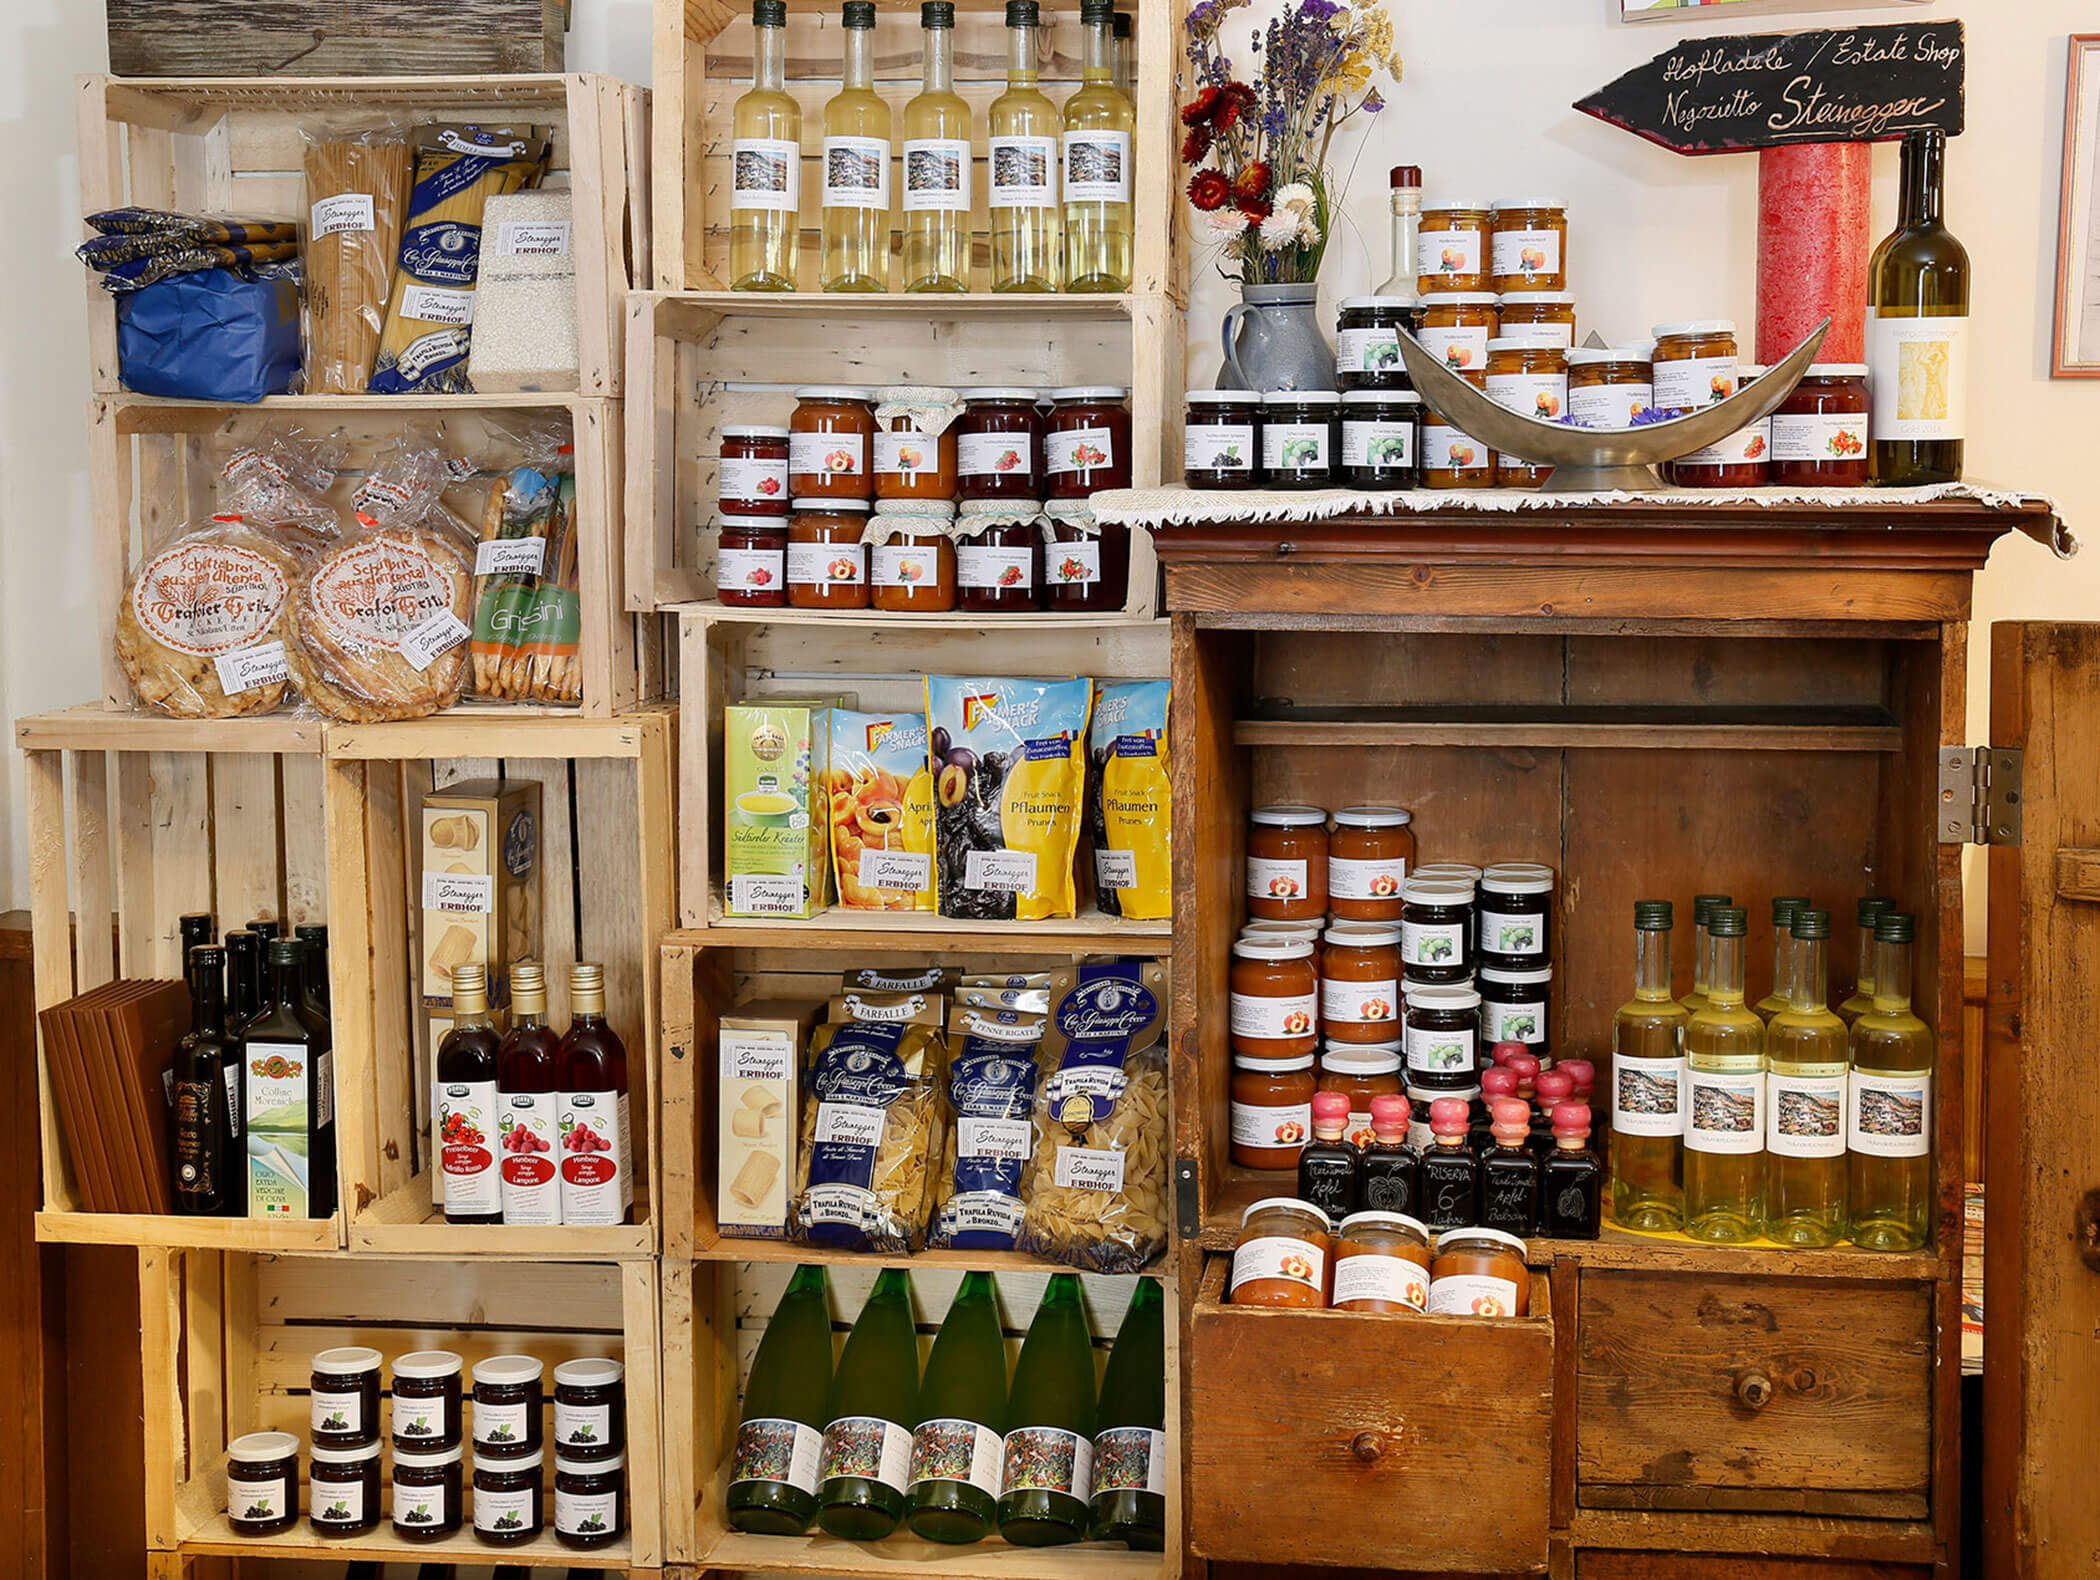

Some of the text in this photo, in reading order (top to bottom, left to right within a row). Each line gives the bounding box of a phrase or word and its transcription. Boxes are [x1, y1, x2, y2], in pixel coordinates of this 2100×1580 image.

[1831, 34, 1908, 66] Estate
[1913, 33, 1961, 71] Shop
[1662, 75, 1946, 136] Negozietto Steinegger
[323, 221, 366, 233] ERBHOF
[515, 246, 560, 255] ERBHOF
[420, 312, 465, 324] ERBHOF
[494, 563, 537, 573] ERBHOF
[971, 698, 1040, 724] FARMER'S
[994, 711, 1038, 735] SNACK
[872, 725, 926, 745] FARMER'S
[889, 735, 926, 752] SNACK
[1011, 801, 1070, 815] Pflaumen
[1107, 799, 1158, 812] Pflaumen
[1026, 818, 1057, 827] Prunes
[1118, 816, 1142, 825] Prunes
[732, 826, 805, 846] Südtiroler Kräuter
[878, 879, 921, 890] ERBHOF
[984, 880, 1028, 891] ERBHOF
[440, 902, 483, 912] ERBHOF
[751, 903, 795, 912] ERBHOF
[875, 979, 927, 990] FARFALLE
[860, 1007, 909, 1019] FARFALLE
[977, 1023, 1034, 1037] PENNE RIGATE
[739, 1070, 784, 1079] ERBHOF
[831, 1134, 873, 1145] ERBHOF
[977, 1148, 1022, 1158] ERBHOF
[513, 1175, 539, 1184] Lampone
[573, 1175, 600, 1184] Lampone
[1429, 1165, 1472, 1182] RISERVA
[1071, 1178, 1115, 1191] ERBHOF
